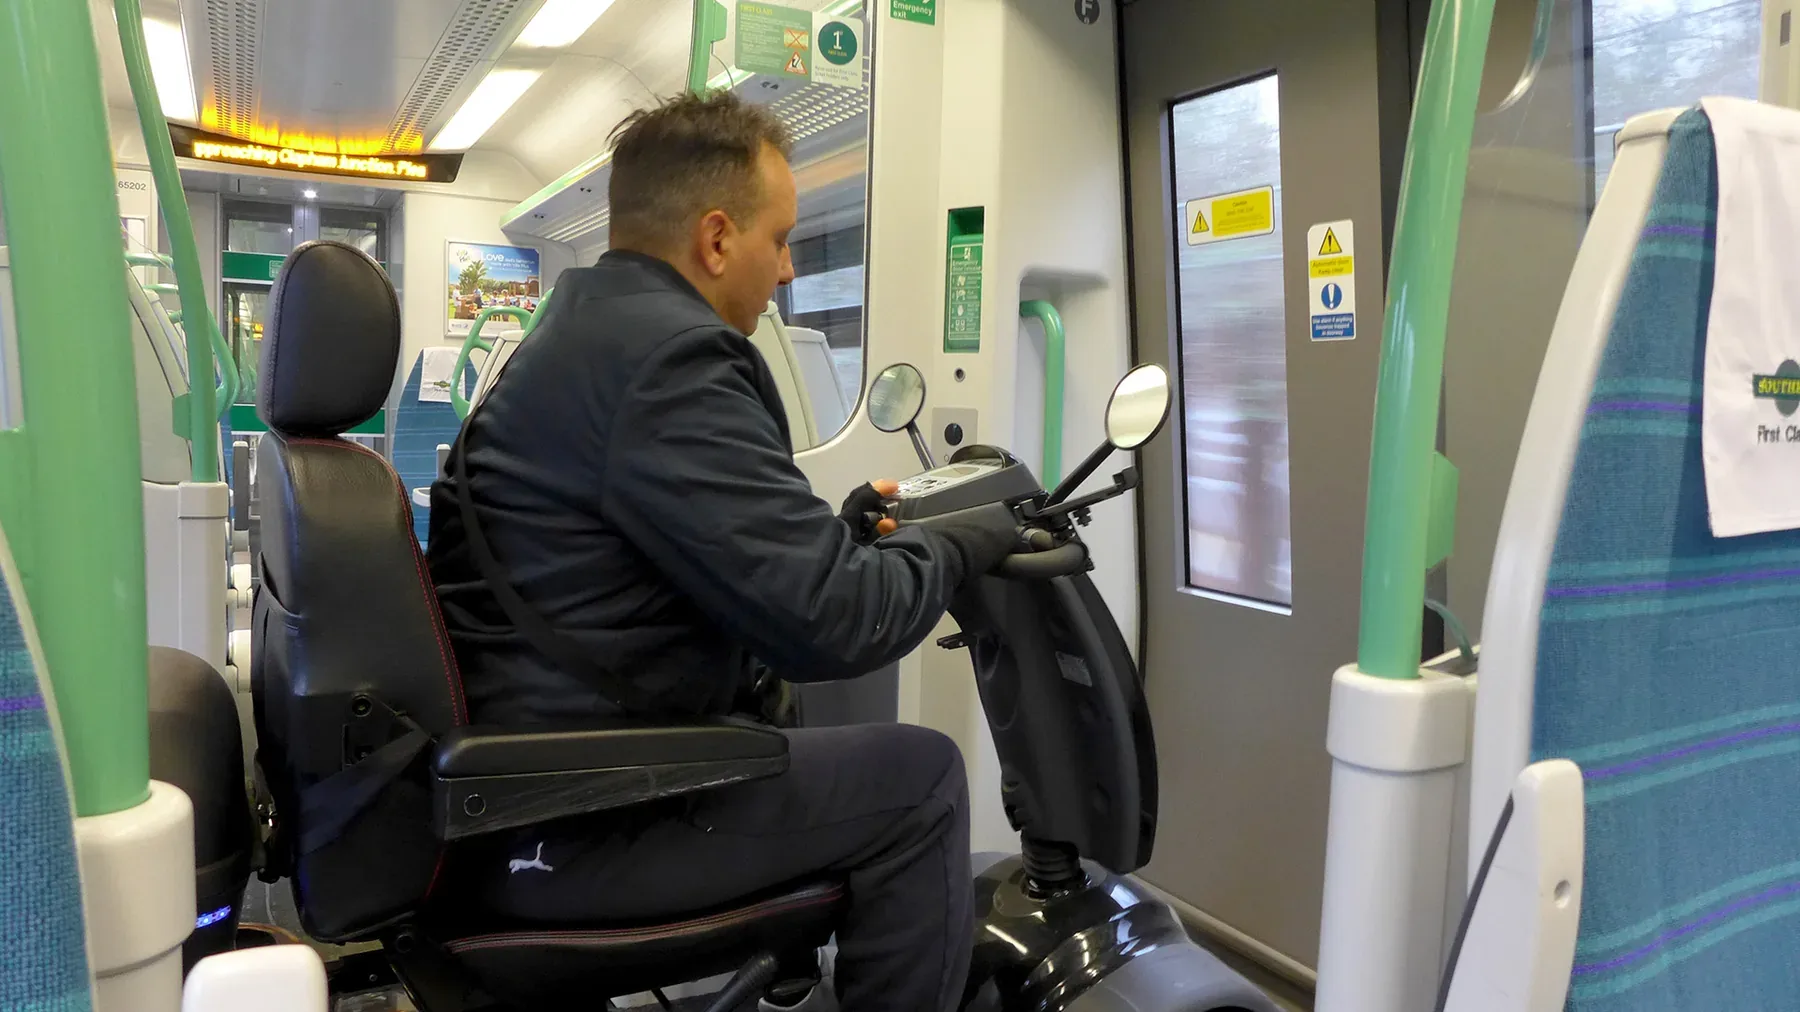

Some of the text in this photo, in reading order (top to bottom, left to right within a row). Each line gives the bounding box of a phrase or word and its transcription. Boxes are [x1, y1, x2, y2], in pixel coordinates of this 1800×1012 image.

[893, 0, 933, 16] Emergency
[893, 10, 907, 19] exit
[279, 149, 338, 168] Clapham
[118, 180, 147, 191] 65202
[480, 251, 504, 262] Love
[1757, 424, 1780, 443] First
